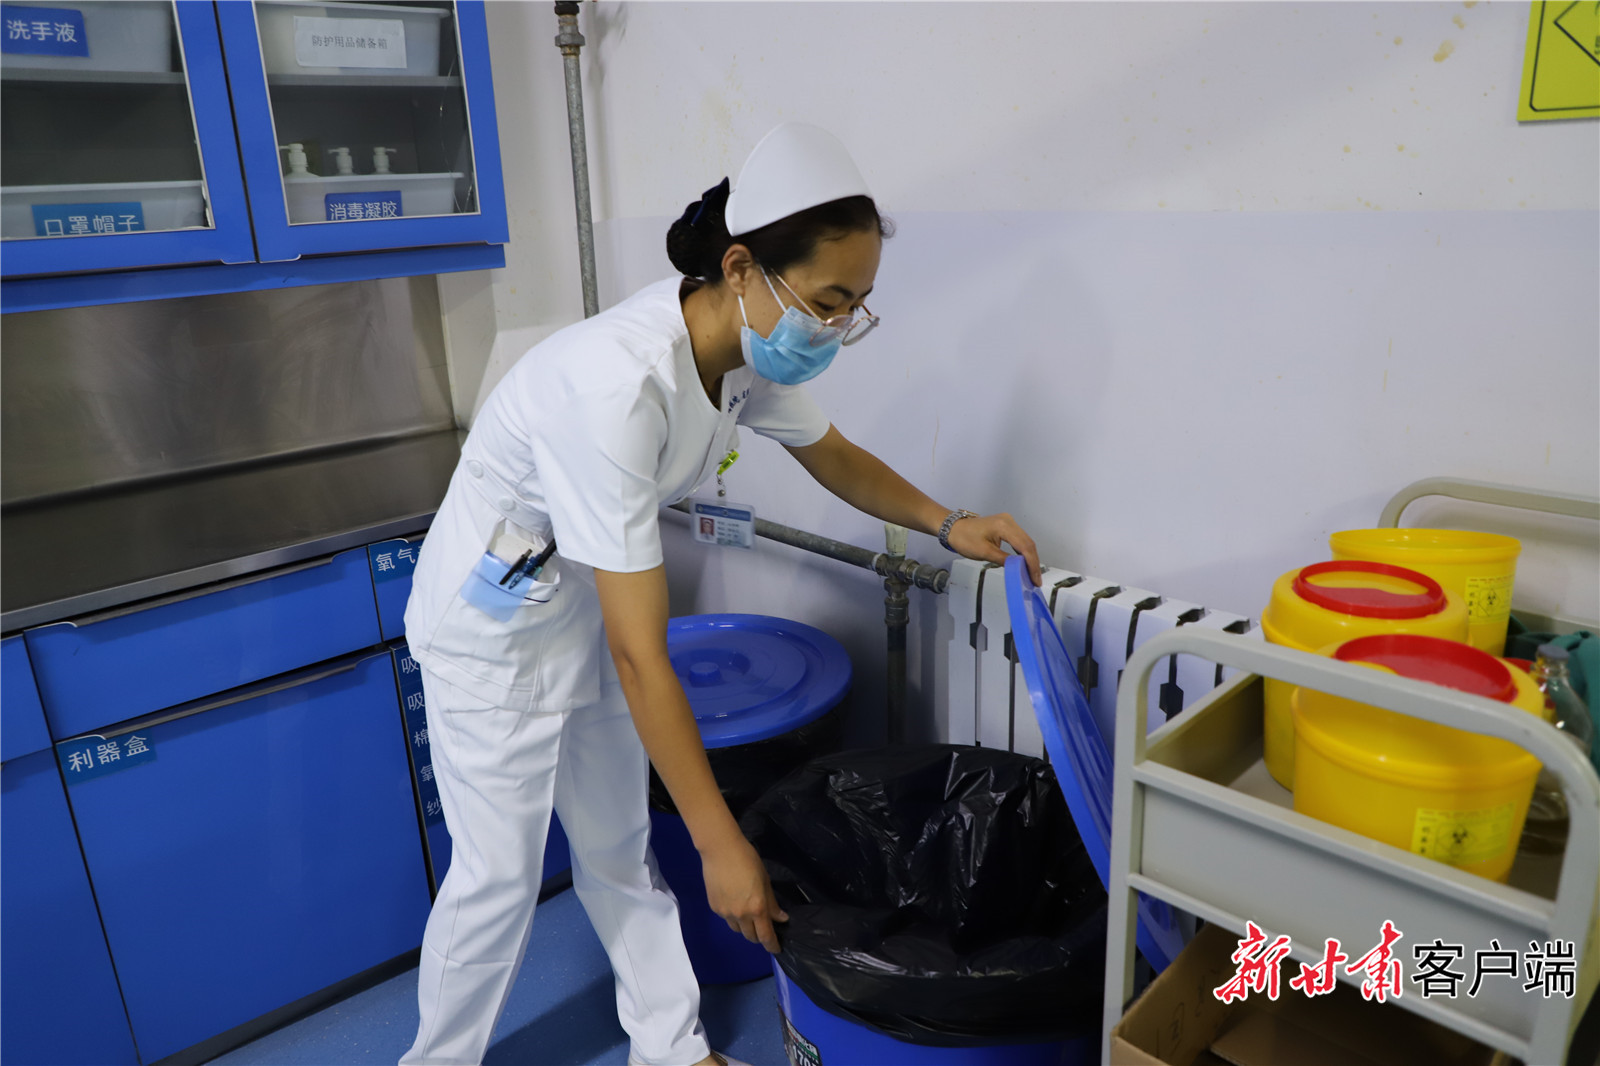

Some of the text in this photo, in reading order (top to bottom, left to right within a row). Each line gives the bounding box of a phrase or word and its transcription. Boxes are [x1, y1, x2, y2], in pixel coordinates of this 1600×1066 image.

[7, 19, 78, 44] 洗手液
[311, 34, 389, 51] 防护用品储备箱
[329, 200, 399, 219] 消毒凝胶
[43, 213, 140, 236] 口罩帽子
[375, 546, 422, 572] 氧气
[68, 735, 150, 773] 利器盒
